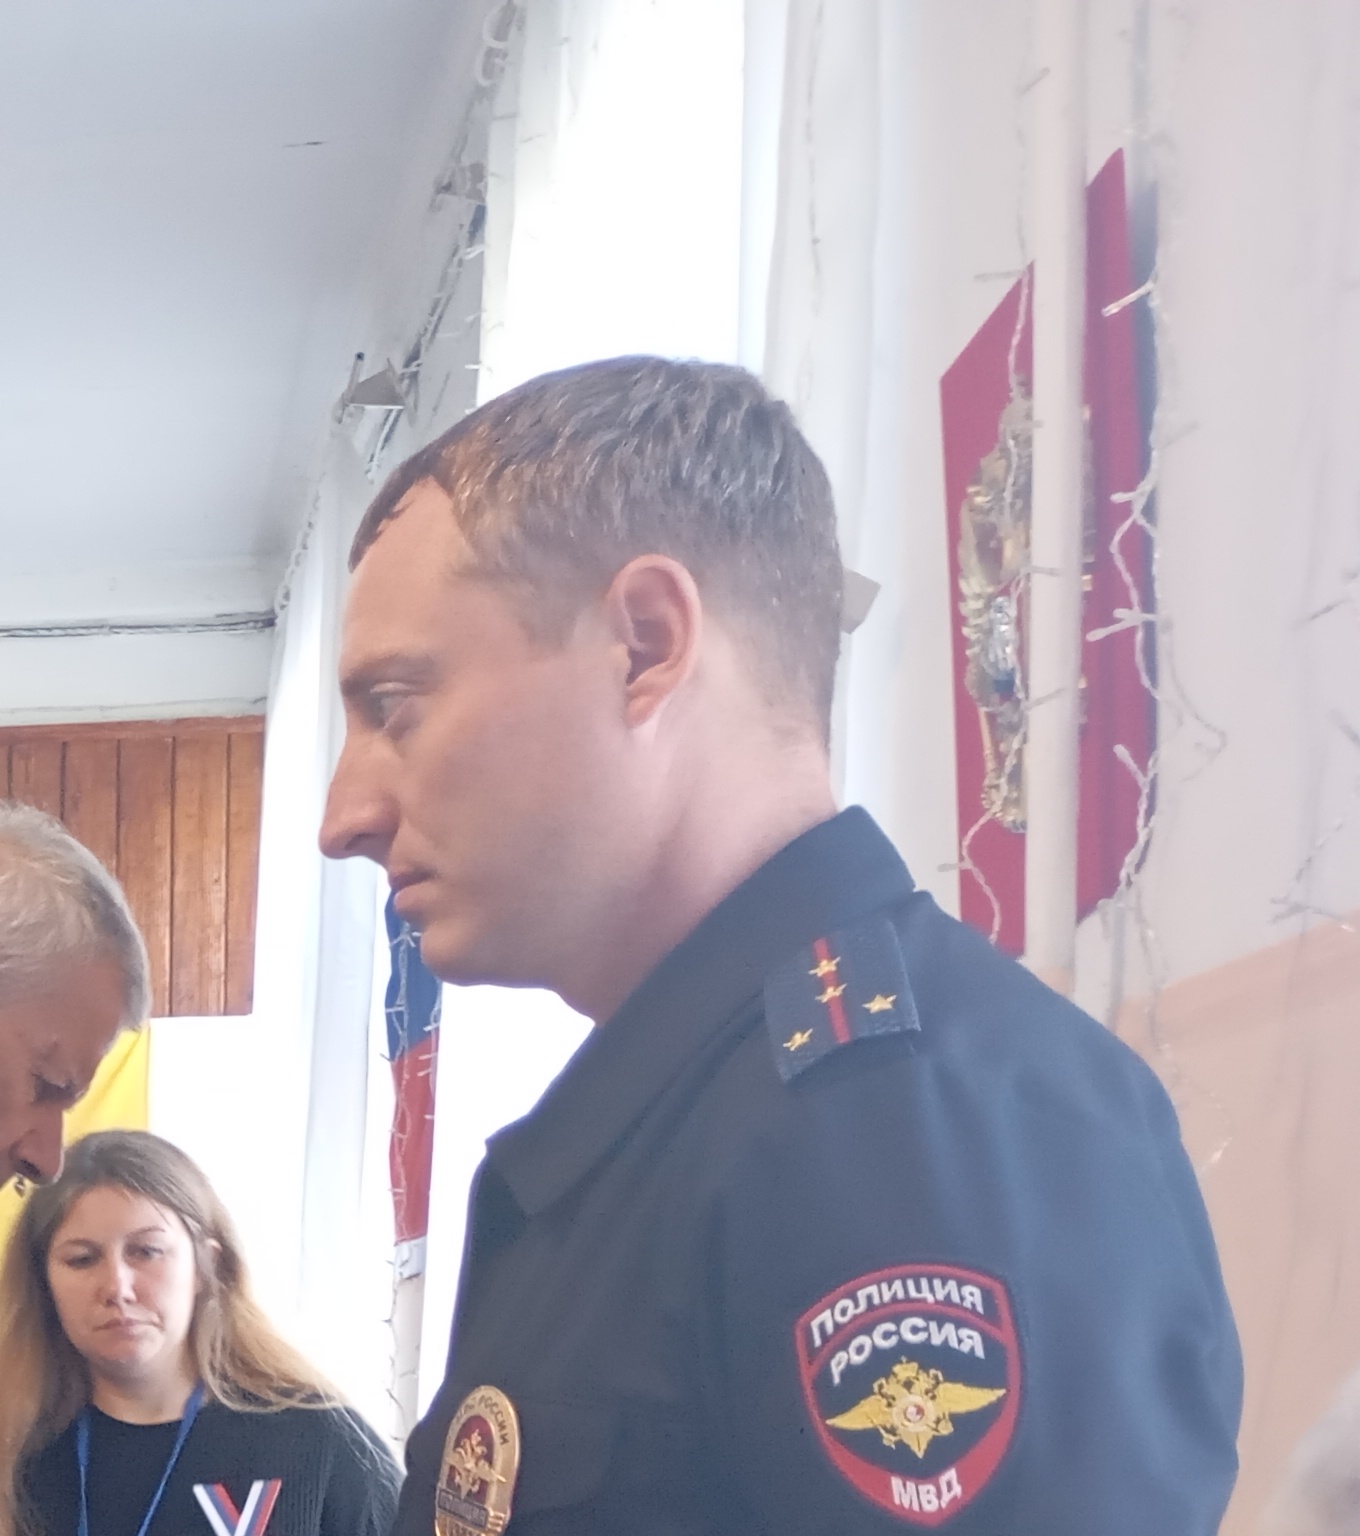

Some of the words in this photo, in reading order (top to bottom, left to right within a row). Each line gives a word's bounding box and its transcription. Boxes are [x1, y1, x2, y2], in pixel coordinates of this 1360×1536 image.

[810, 1277, 985, 1348] ПОЛИЦИЯ
[830, 1316, 985, 1387] РОССИЯ
[890, 1466, 963, 1513] МВД
